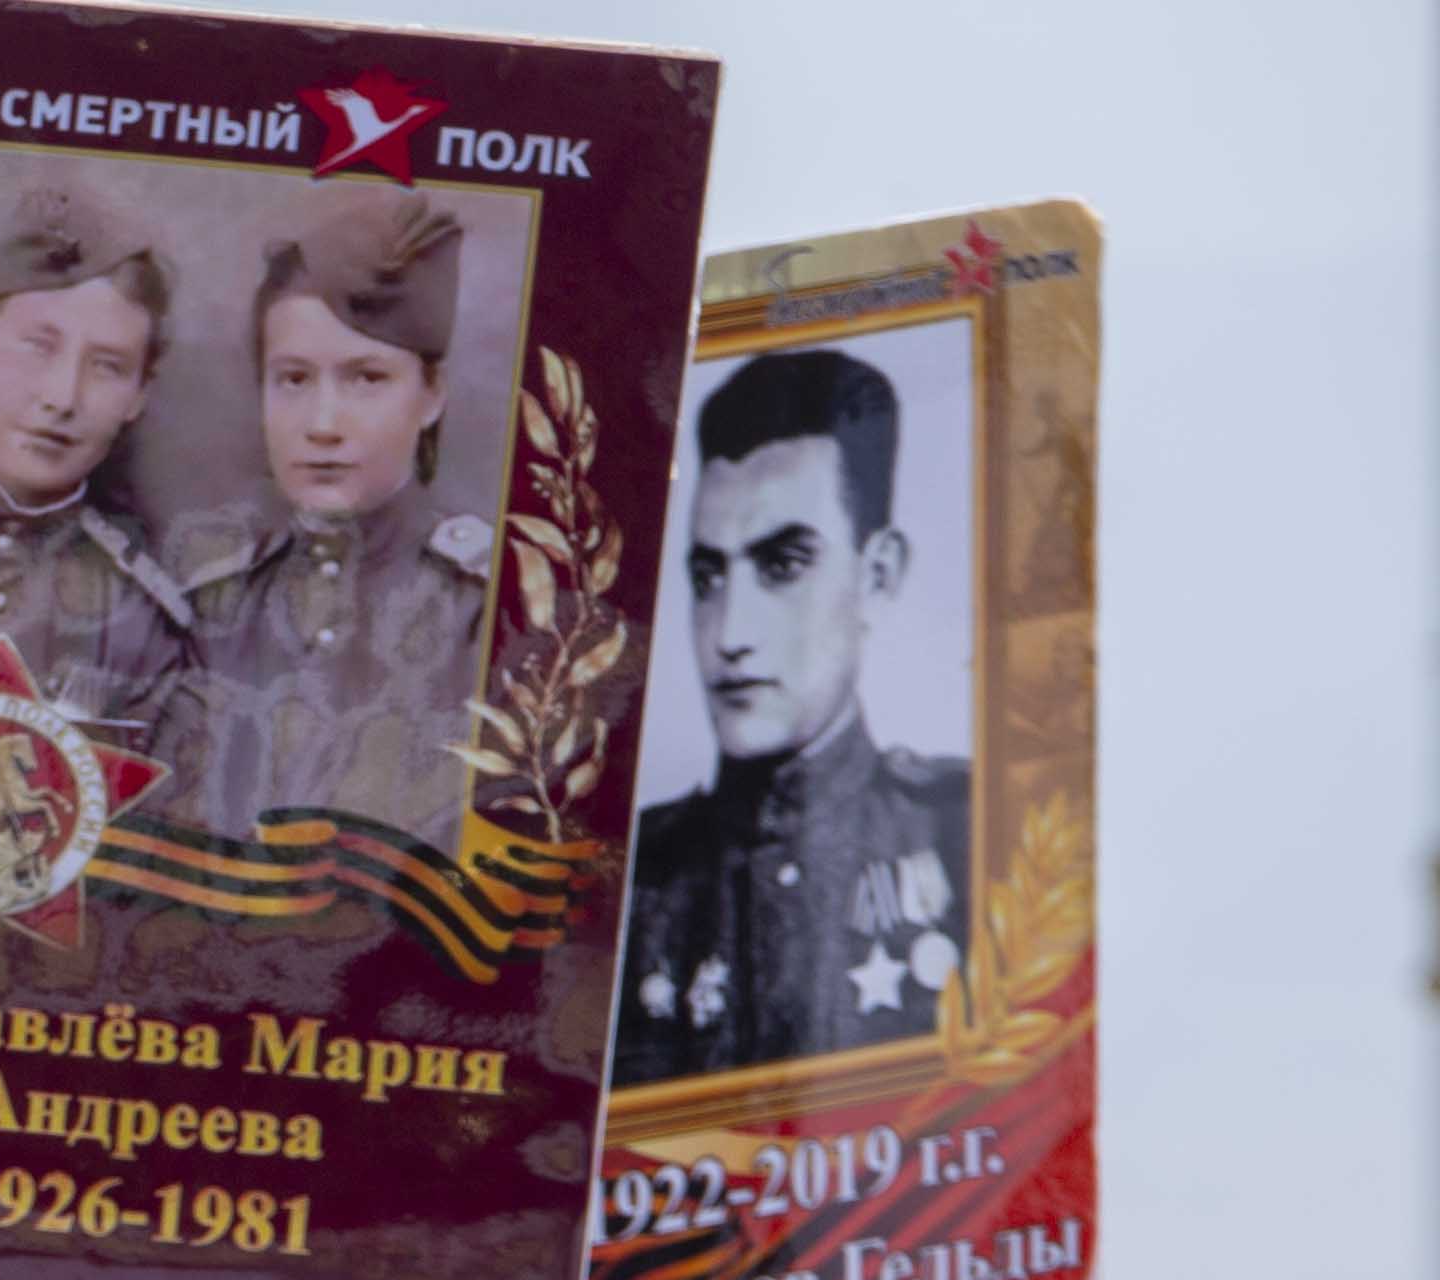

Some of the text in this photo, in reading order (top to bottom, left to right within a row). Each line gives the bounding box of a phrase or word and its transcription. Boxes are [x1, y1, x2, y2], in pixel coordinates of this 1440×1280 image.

[436, 125, 591, 178] ПОЛК
[246, 1012, 507, 1103] Мария
[919, 1127, 1004, 1187] г.г.
